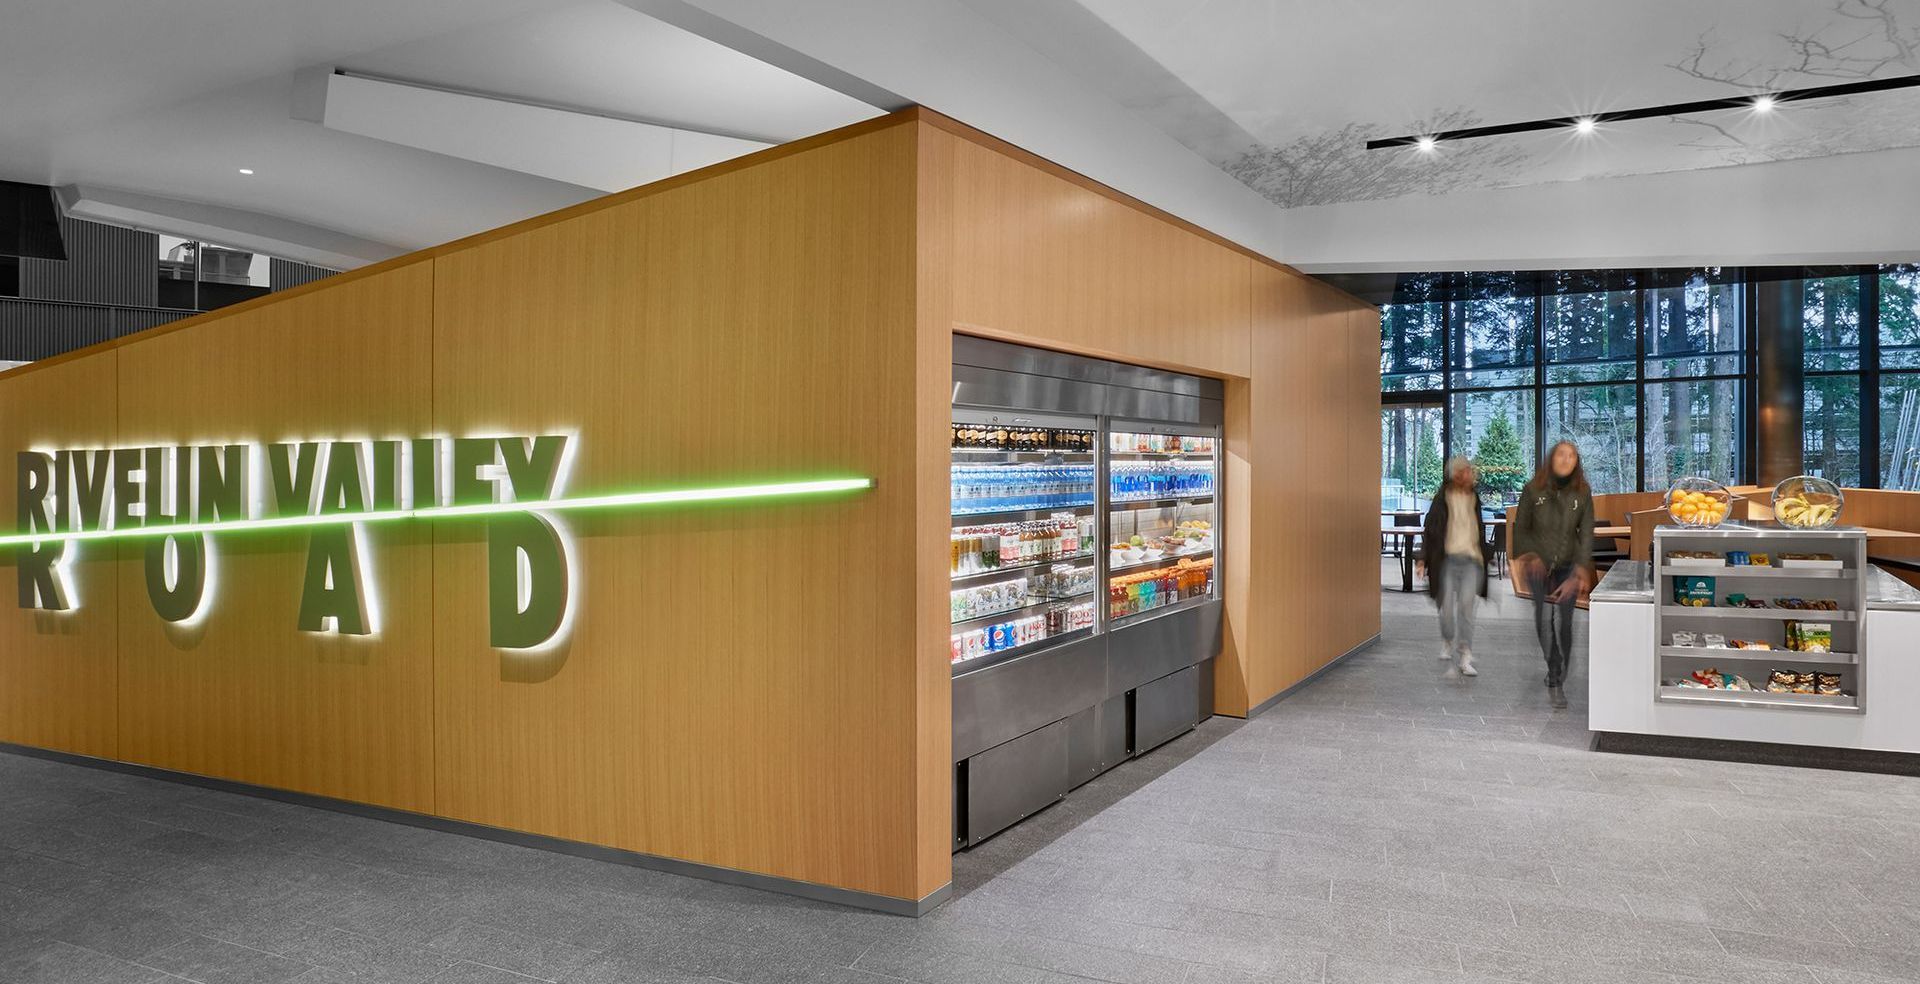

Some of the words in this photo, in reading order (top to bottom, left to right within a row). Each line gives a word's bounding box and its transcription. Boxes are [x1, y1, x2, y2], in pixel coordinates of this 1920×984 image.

[17, 444, 251, 535] RIVELIN
[268, 435, 567, 516] VALLEY
[17, 509, 569, 649] ROAD
